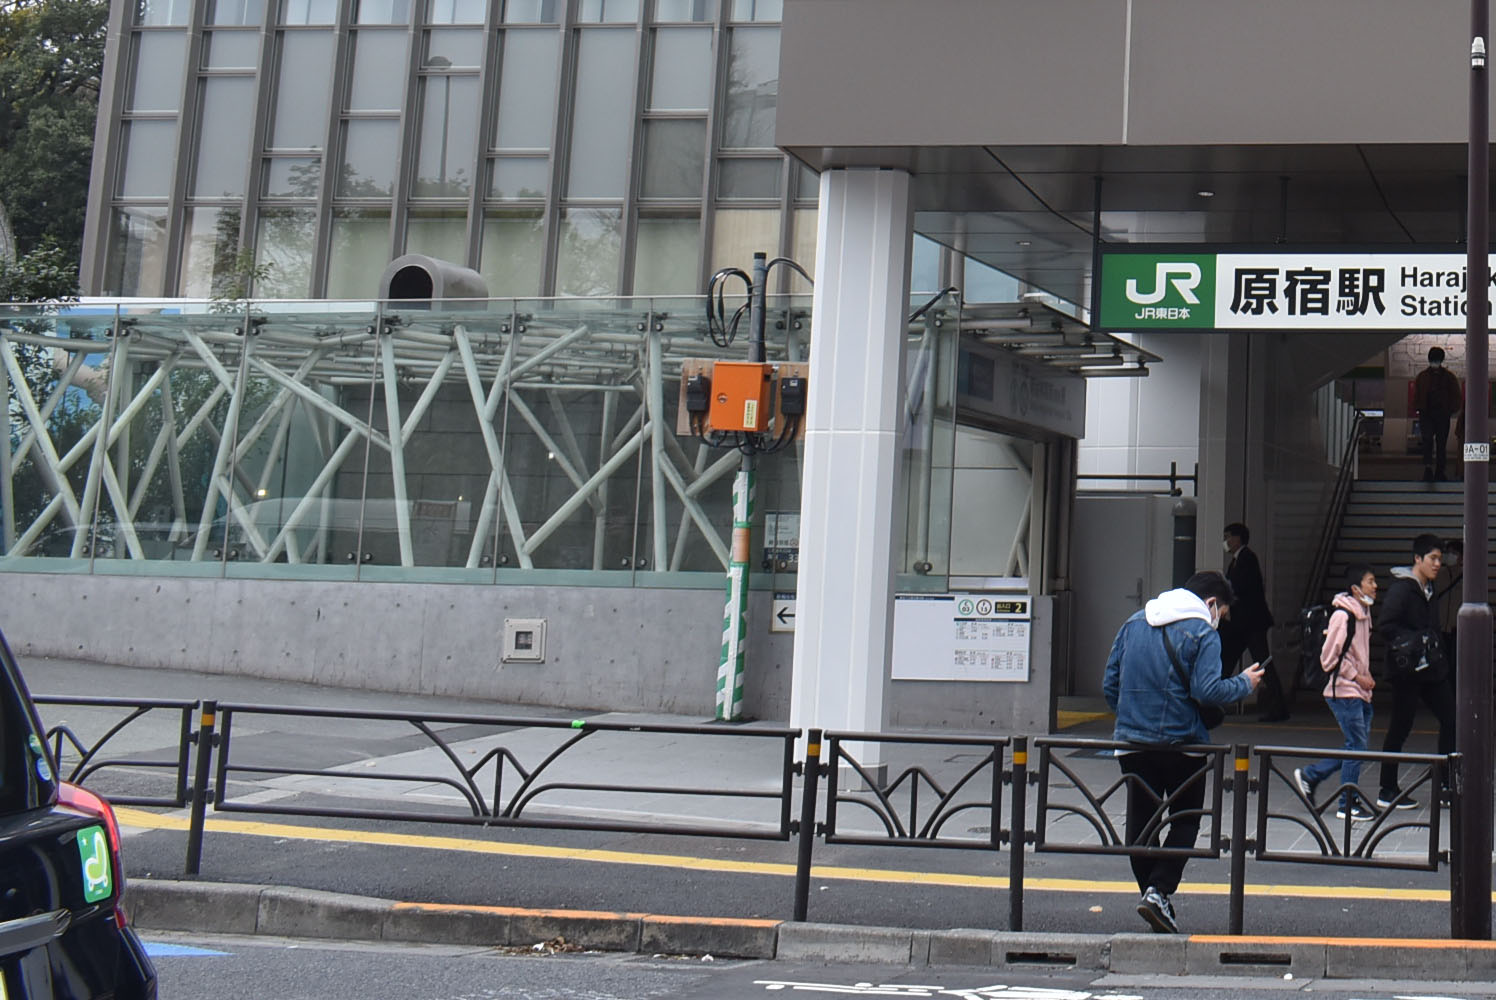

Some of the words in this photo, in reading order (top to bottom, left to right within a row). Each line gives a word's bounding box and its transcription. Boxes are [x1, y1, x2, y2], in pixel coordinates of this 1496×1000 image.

[1125, 262, 1202, 304] JR
[1229, 267, 1386, 317] 原宿駅
[1134, 307, 1192, 321] JR東日本
[1015, 602, 1022, 614] 2
